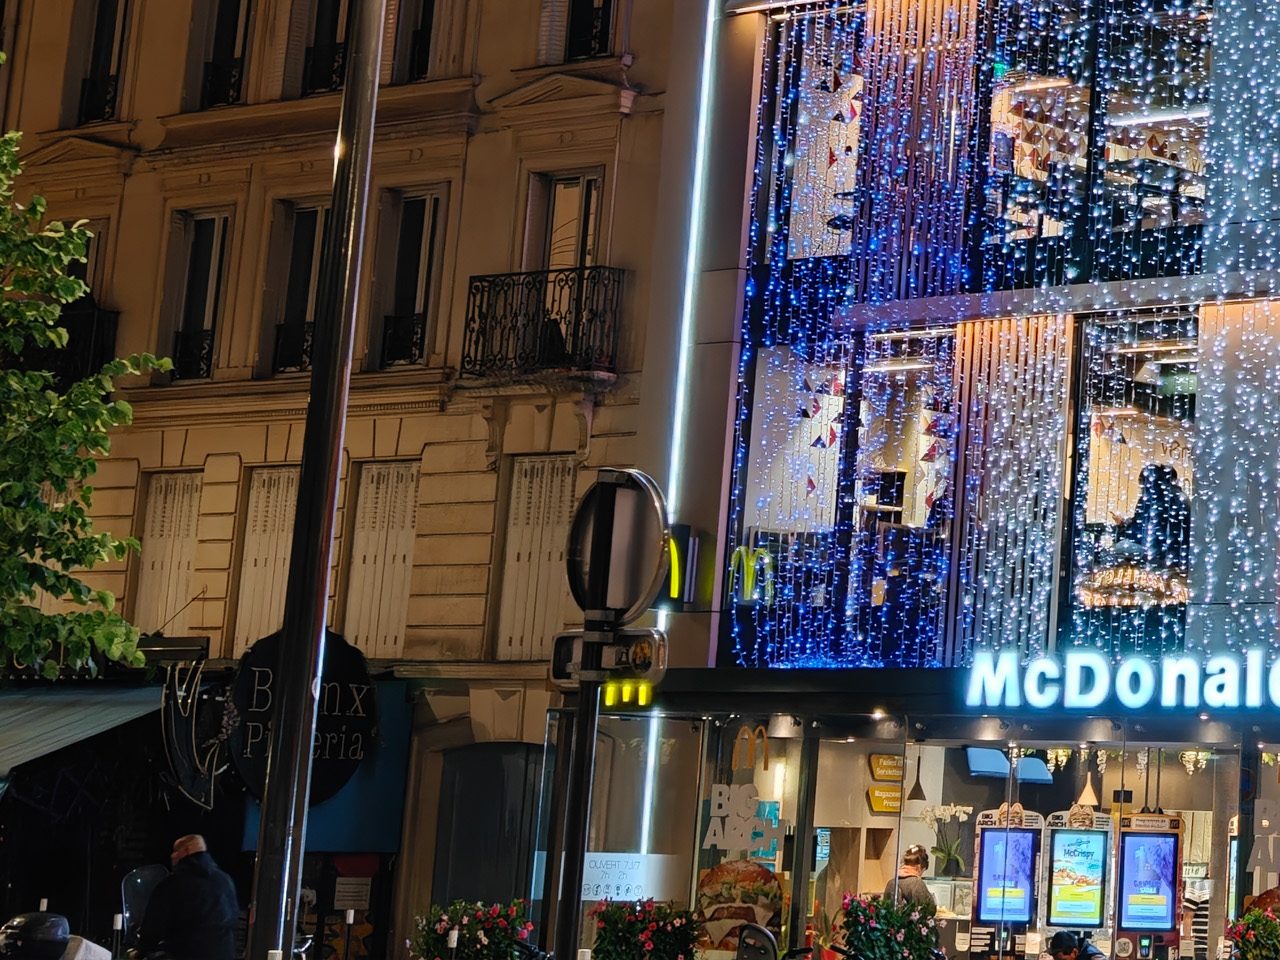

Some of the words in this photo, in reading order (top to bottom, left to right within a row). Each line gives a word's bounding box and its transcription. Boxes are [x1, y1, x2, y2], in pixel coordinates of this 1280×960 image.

[248, 666, 370, 717] Bnx
[243, 722, 364, 760] Pieria
[710, 783, 758, 818] BIG
[702, 816, 786, 852] ARCH
[588, 859, 621, 870] OUVERT
[1063, 848, 1095, 860] McCrispy
